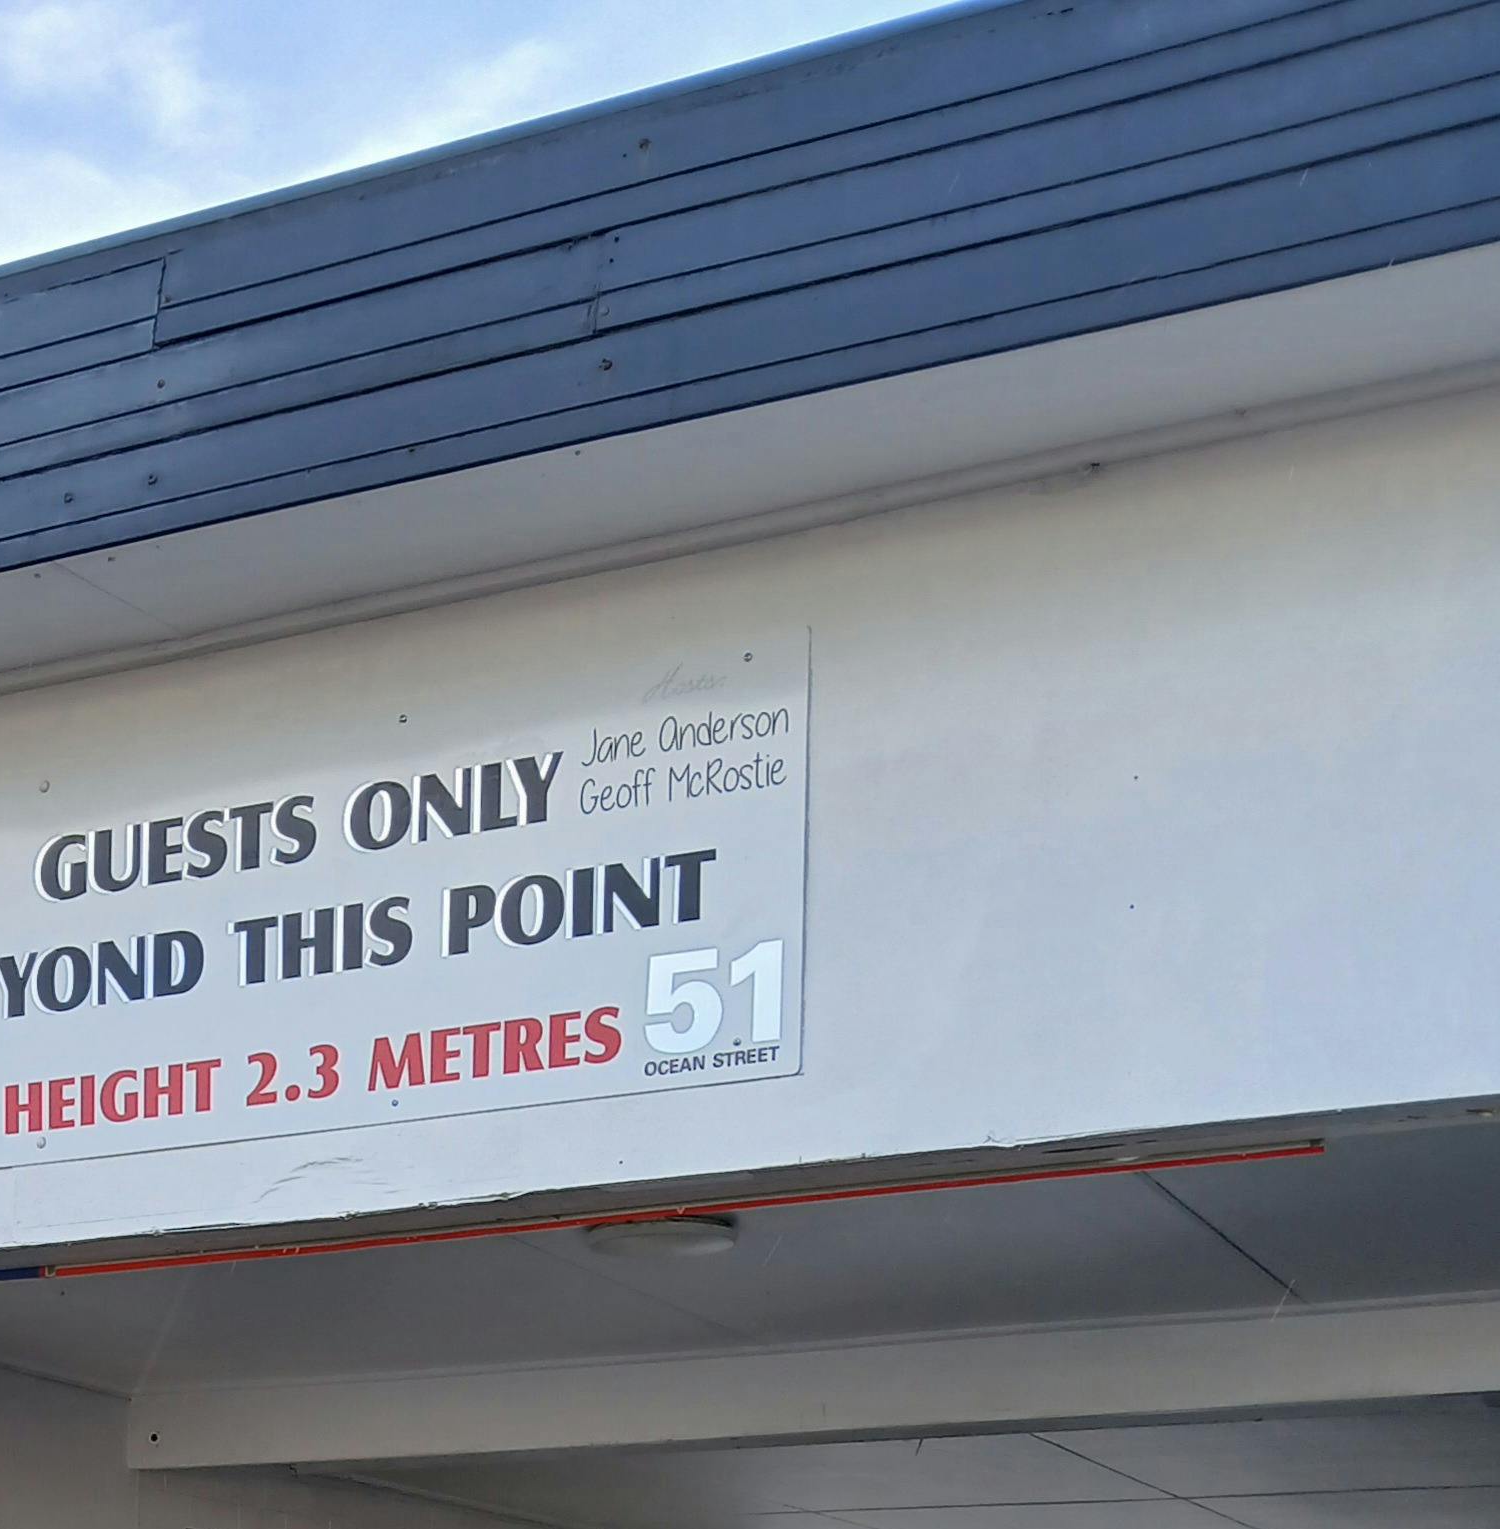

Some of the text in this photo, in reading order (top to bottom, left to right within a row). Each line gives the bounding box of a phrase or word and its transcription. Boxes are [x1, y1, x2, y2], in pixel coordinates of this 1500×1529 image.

[580, 752, 787, 814] Geoff McRostie
[581, 707, 789, 766] Jane Anderson
[34, 751, 563, 902] GUESTS ONLY
[228, 896, 413, 987] THIS
[440, 849, 717, 958] POINT
[644, 939, 783, 1054] 51
[3, 1058, 222, 1135] HEIGHT
[245, 1043, 340, 1107] 2.3
[367, 1005, 622, 1093] METRES
[644, 1046, 780, 1076] OCEAN STREET
